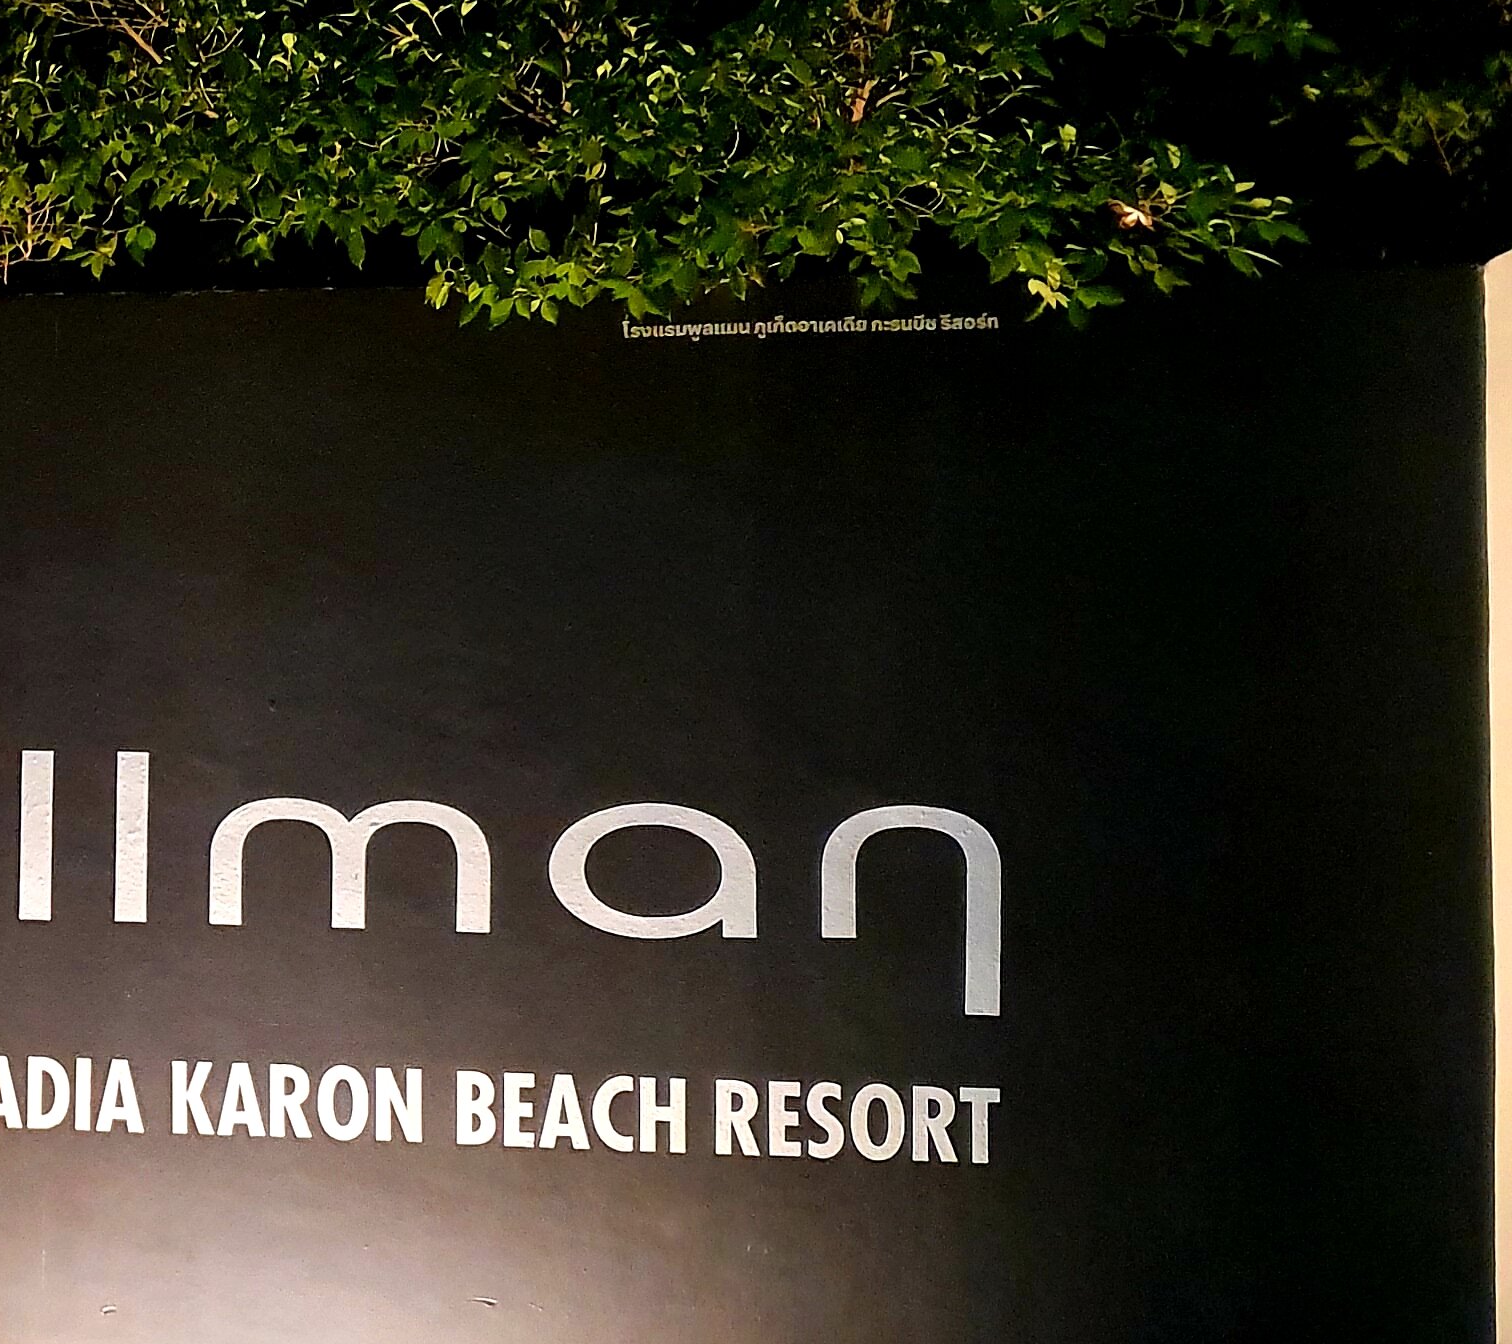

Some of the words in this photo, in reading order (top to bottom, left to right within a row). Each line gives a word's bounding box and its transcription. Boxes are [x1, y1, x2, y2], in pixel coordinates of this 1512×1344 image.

[171, 1060, 423, 1144] KARON
[456, 1070, 687, 1154] BEACH
[715, 1078, 1001, 1164] RESORT
